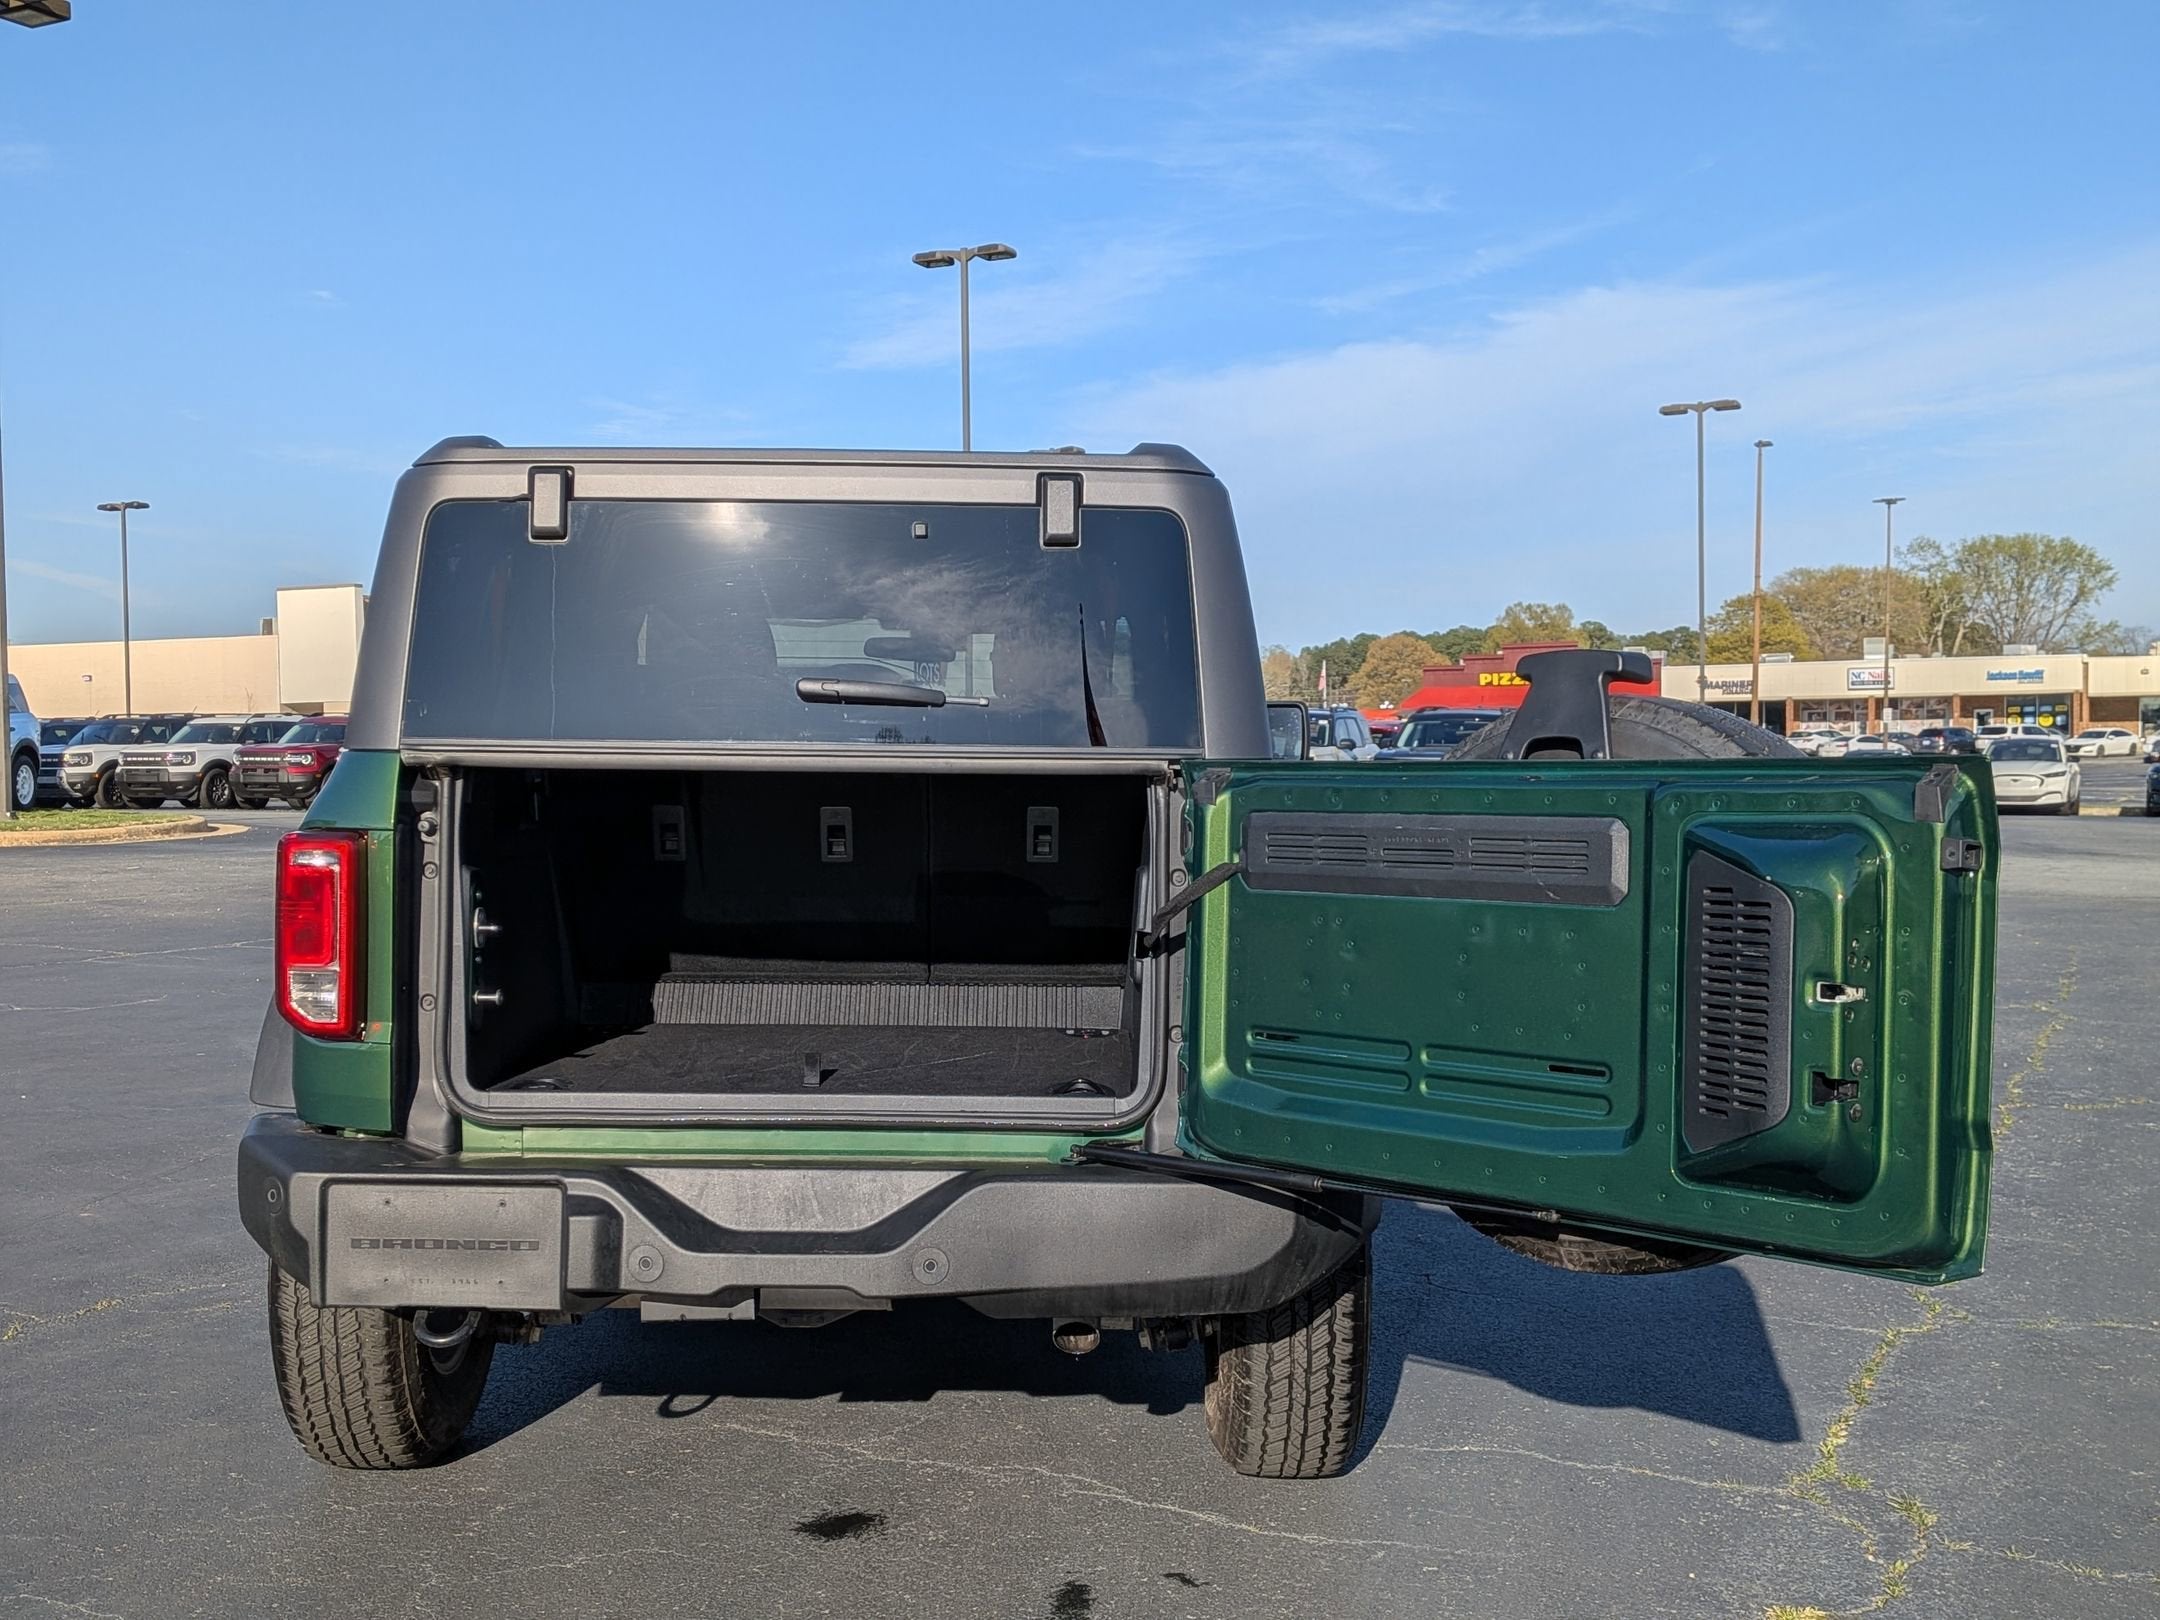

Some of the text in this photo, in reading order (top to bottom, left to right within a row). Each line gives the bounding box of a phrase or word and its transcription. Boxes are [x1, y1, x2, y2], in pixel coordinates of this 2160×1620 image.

[916, 662, 940, 682] LOTS
[1851, 671, 1866, 680] NC
[1479, 672, 1531, 686] PIZZ
[350, 1238, 540, 1251] BRONCO
